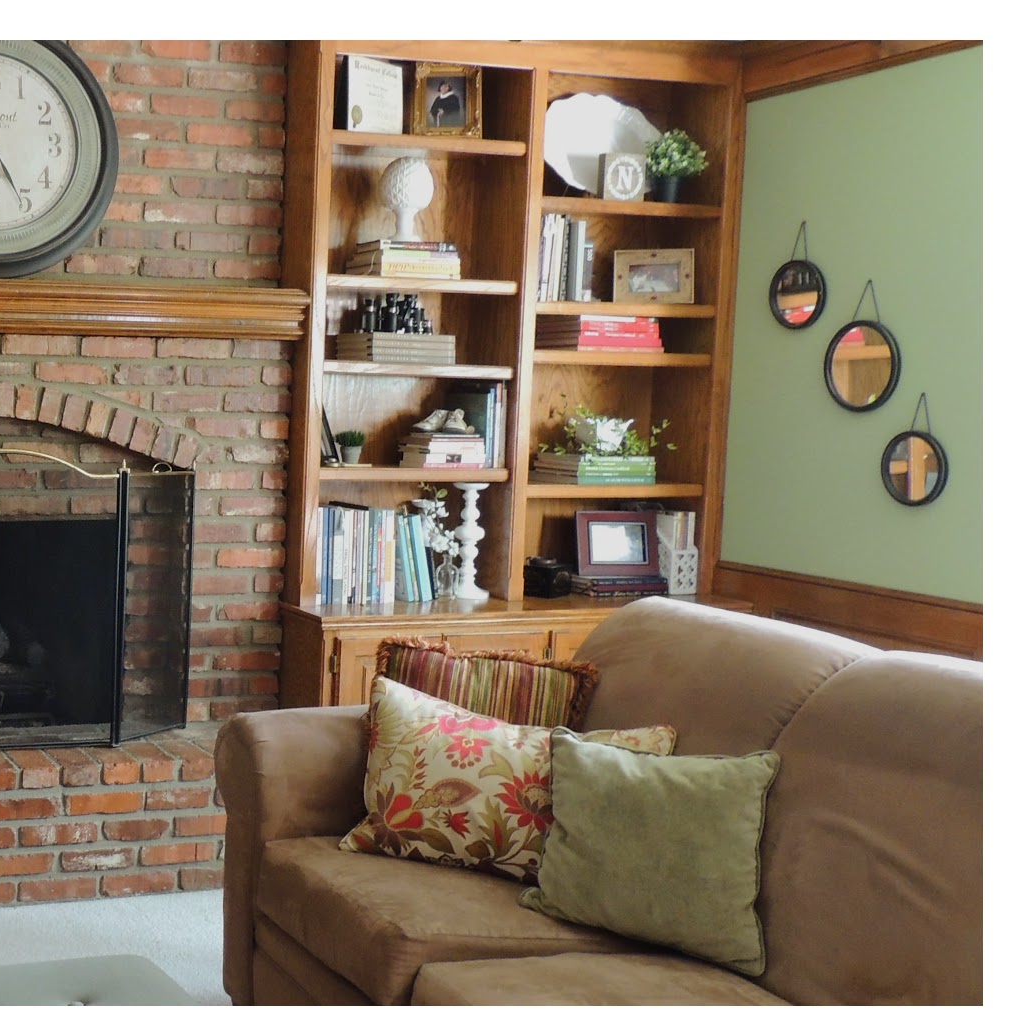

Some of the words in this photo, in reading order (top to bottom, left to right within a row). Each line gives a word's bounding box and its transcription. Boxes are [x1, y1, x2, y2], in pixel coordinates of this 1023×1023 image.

[17, 76, 25, 100] 1
[38, 101, 51, 126] 2
[48, 132, 62, 158] 3
[37, 165, 53, 190] 4
[617, 166, 634, 190] N
[19, 188, 33, 213] 5
